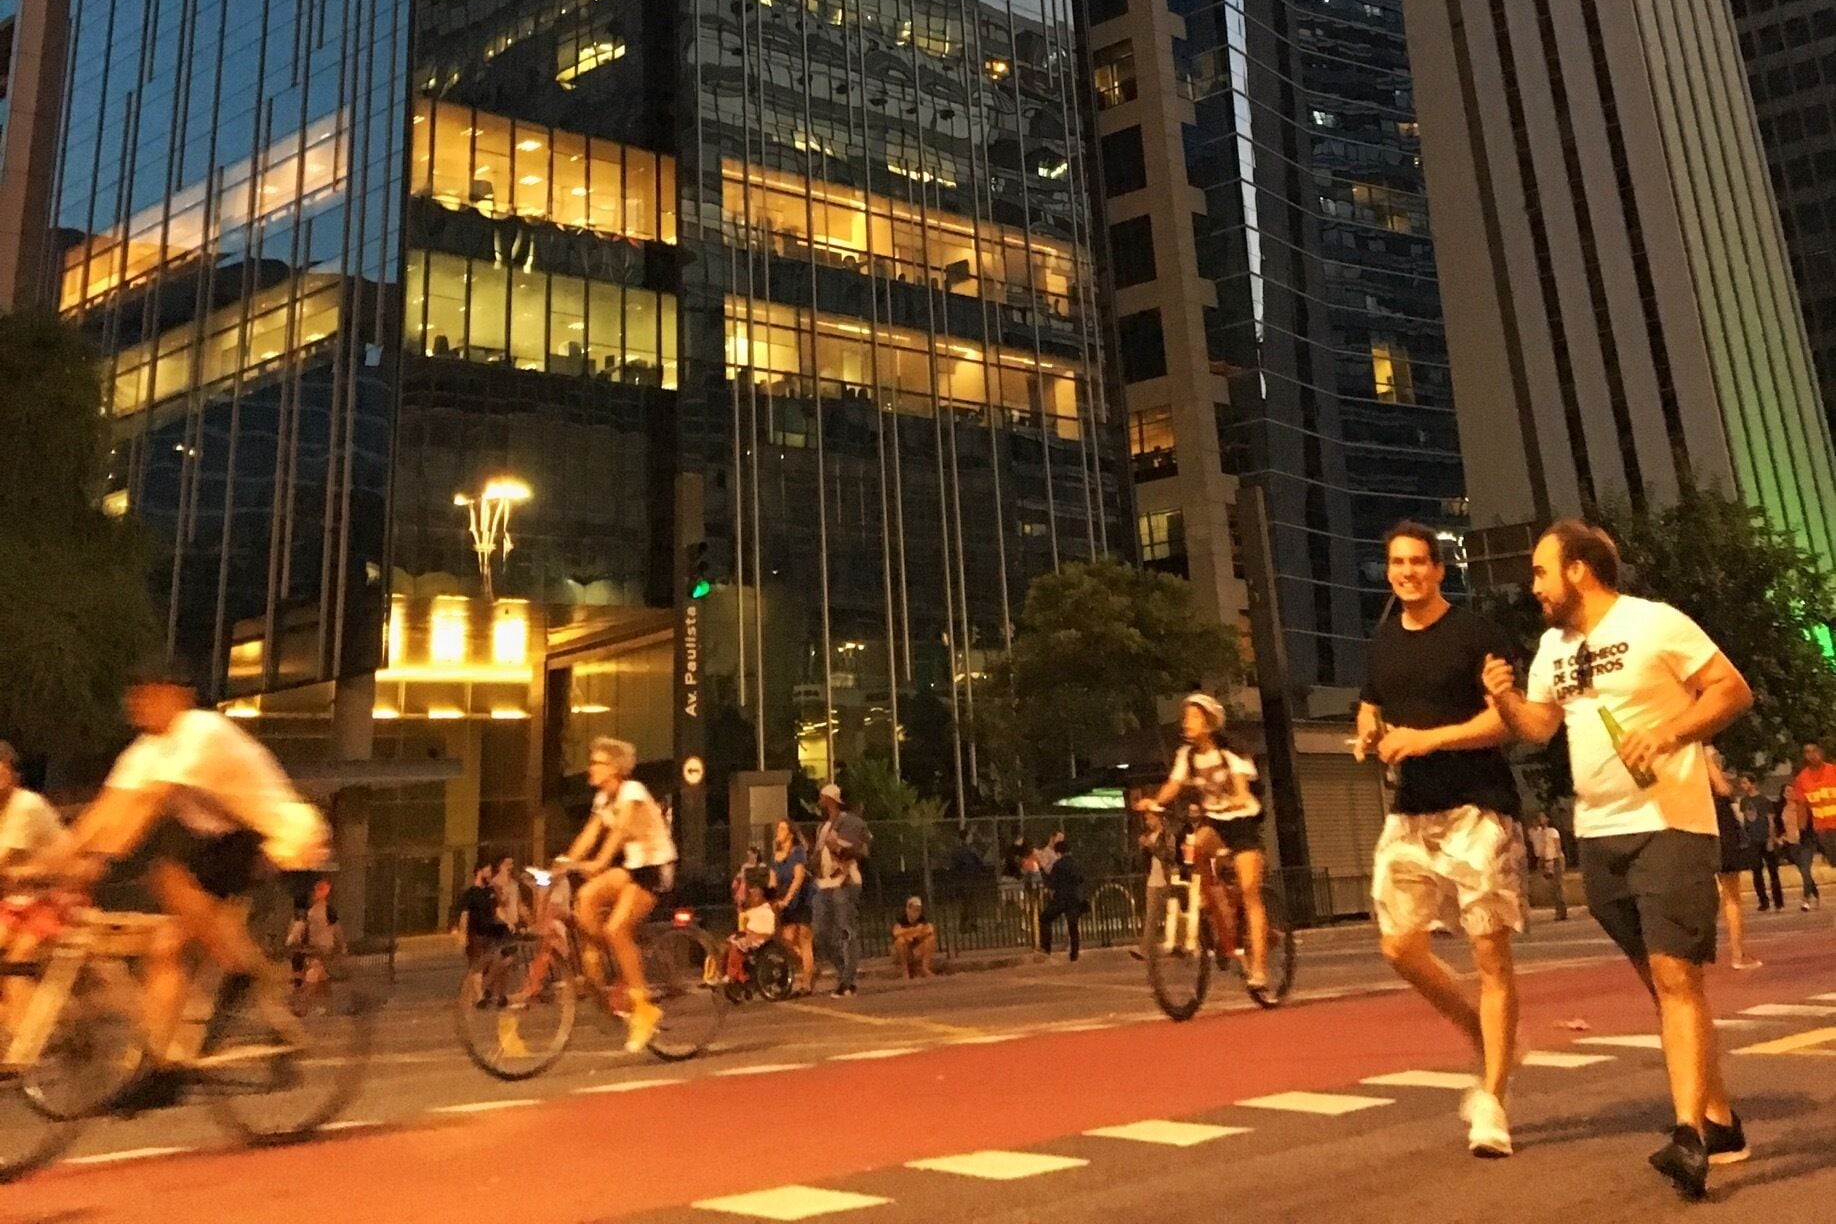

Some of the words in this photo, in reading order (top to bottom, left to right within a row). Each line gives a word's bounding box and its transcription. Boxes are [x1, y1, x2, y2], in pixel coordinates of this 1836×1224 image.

[684, 606, 697, 685] Paulista
[1570, 658, 1624, 681] OTROS
[684, 691, 697, 717] Av.
